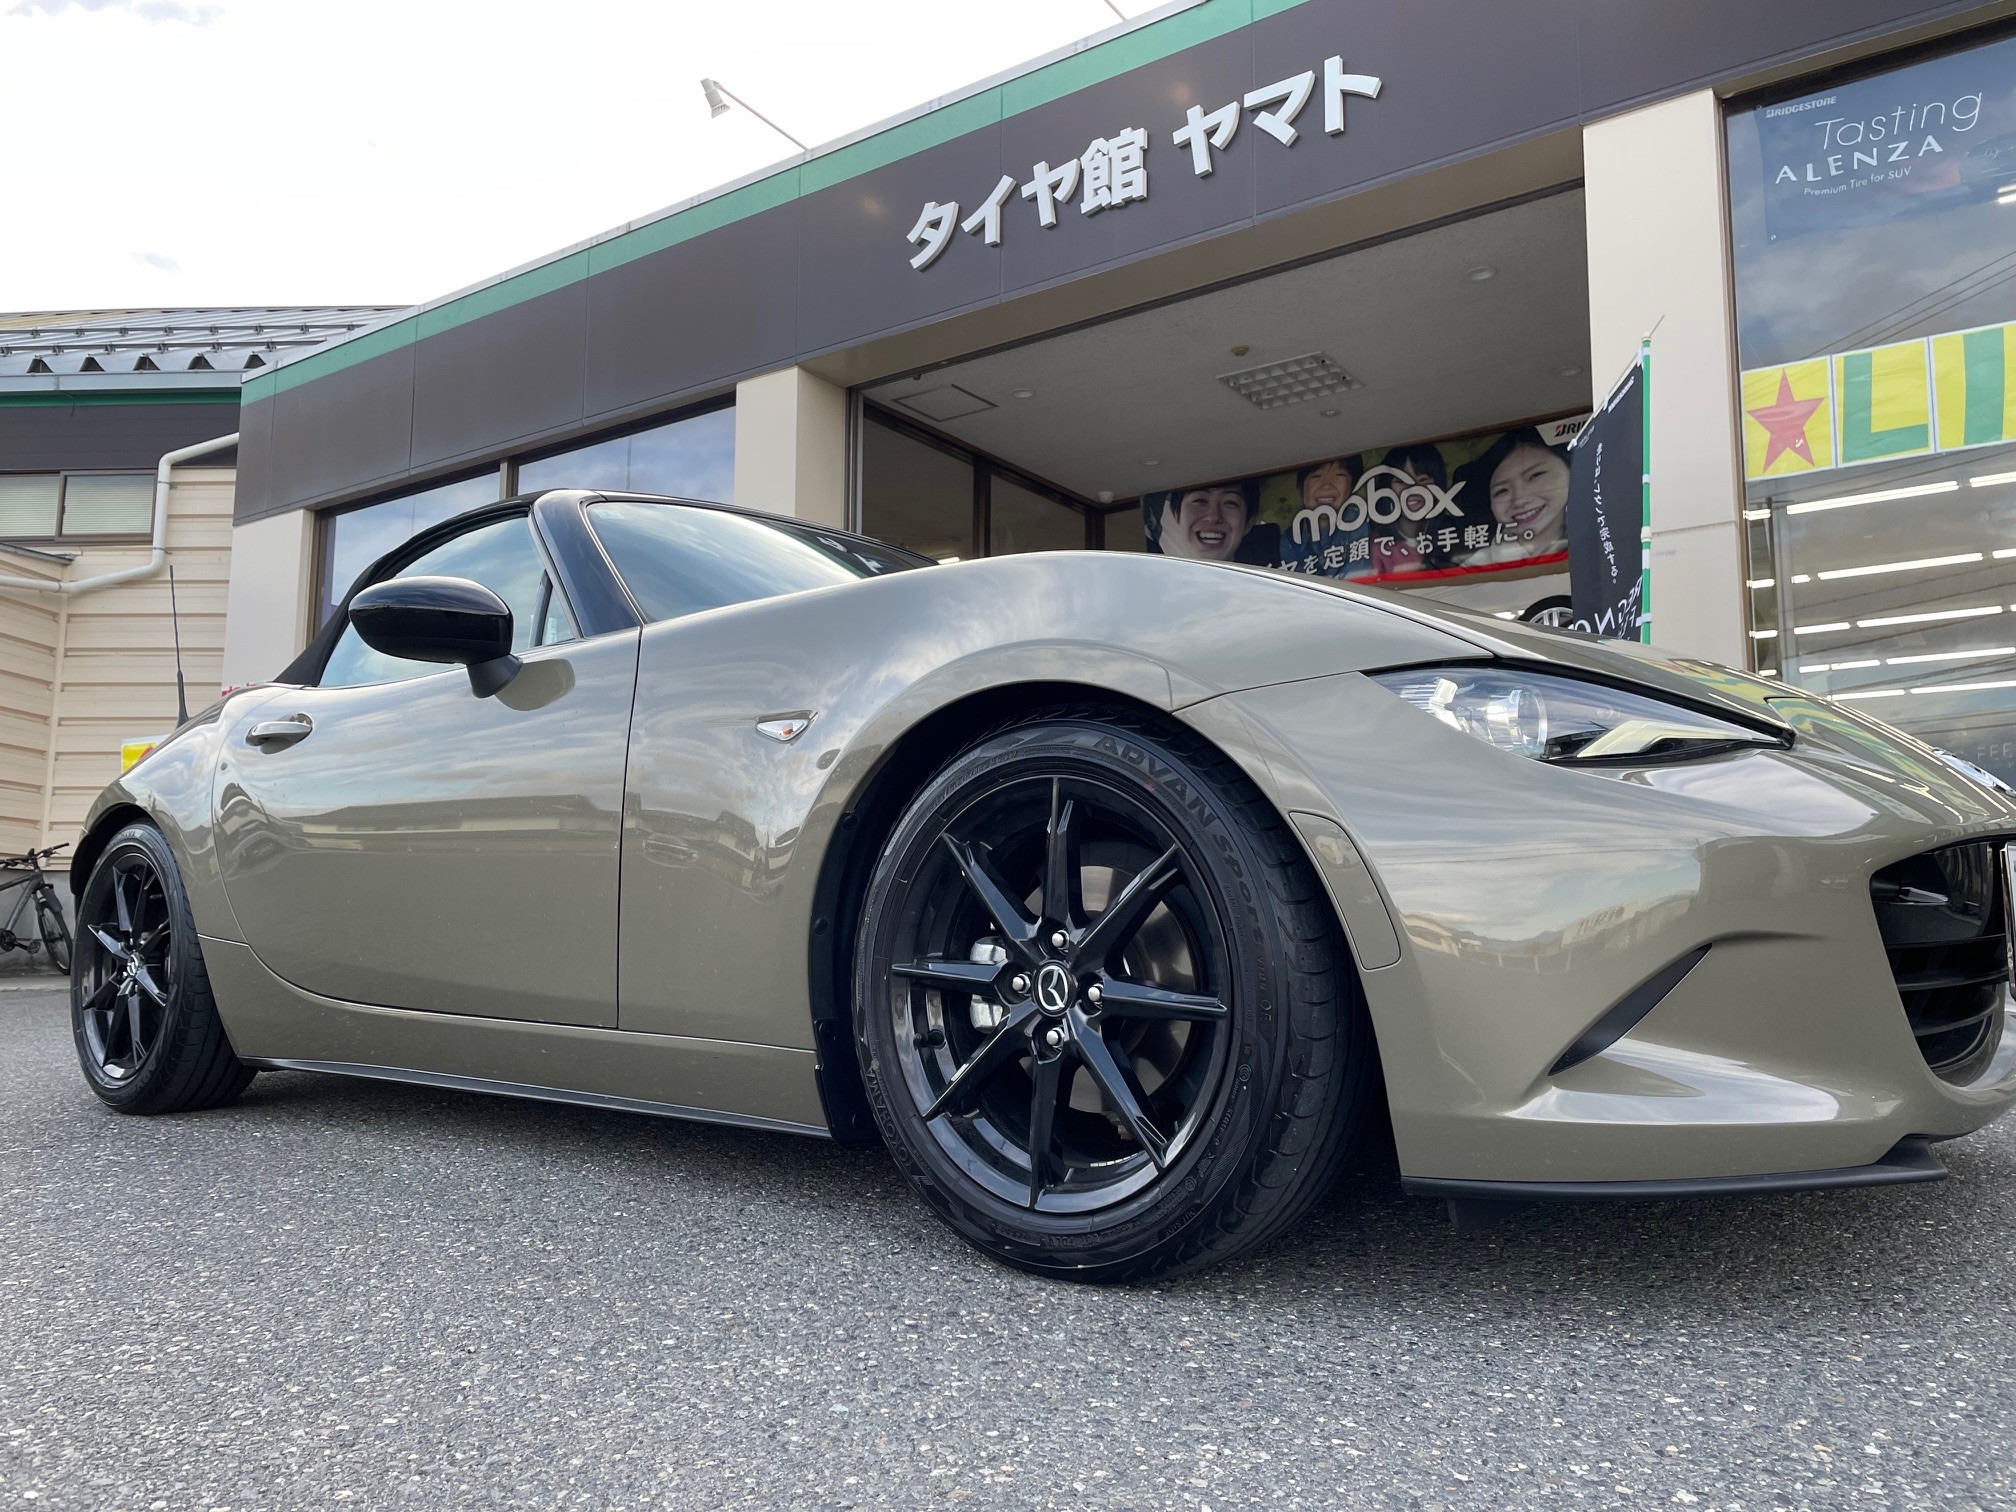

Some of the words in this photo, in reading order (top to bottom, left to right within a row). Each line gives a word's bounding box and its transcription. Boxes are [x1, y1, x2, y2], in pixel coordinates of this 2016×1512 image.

[1765, 95, 1837, 119] BRIDGESTONE
[1814, 91, 1983, 150] Tasting
[906, 126, 1149, 271] タイヤ館
[1172, 55, 1383, 178] ヤマト
[1774, 134, 1943, 185] ALENZA
[1803, 182, 1847, 196] Premium
[1849, 177, 1869, 189] Tire
[1870, 172, 1885, 184] for
[1888, 166, 1912, 180] SUV
[1553, 421, 1588, 438] BRI
[1292, 466, 1467, 546] mobox
[1092, 735, 1220, 830] ADVAN
